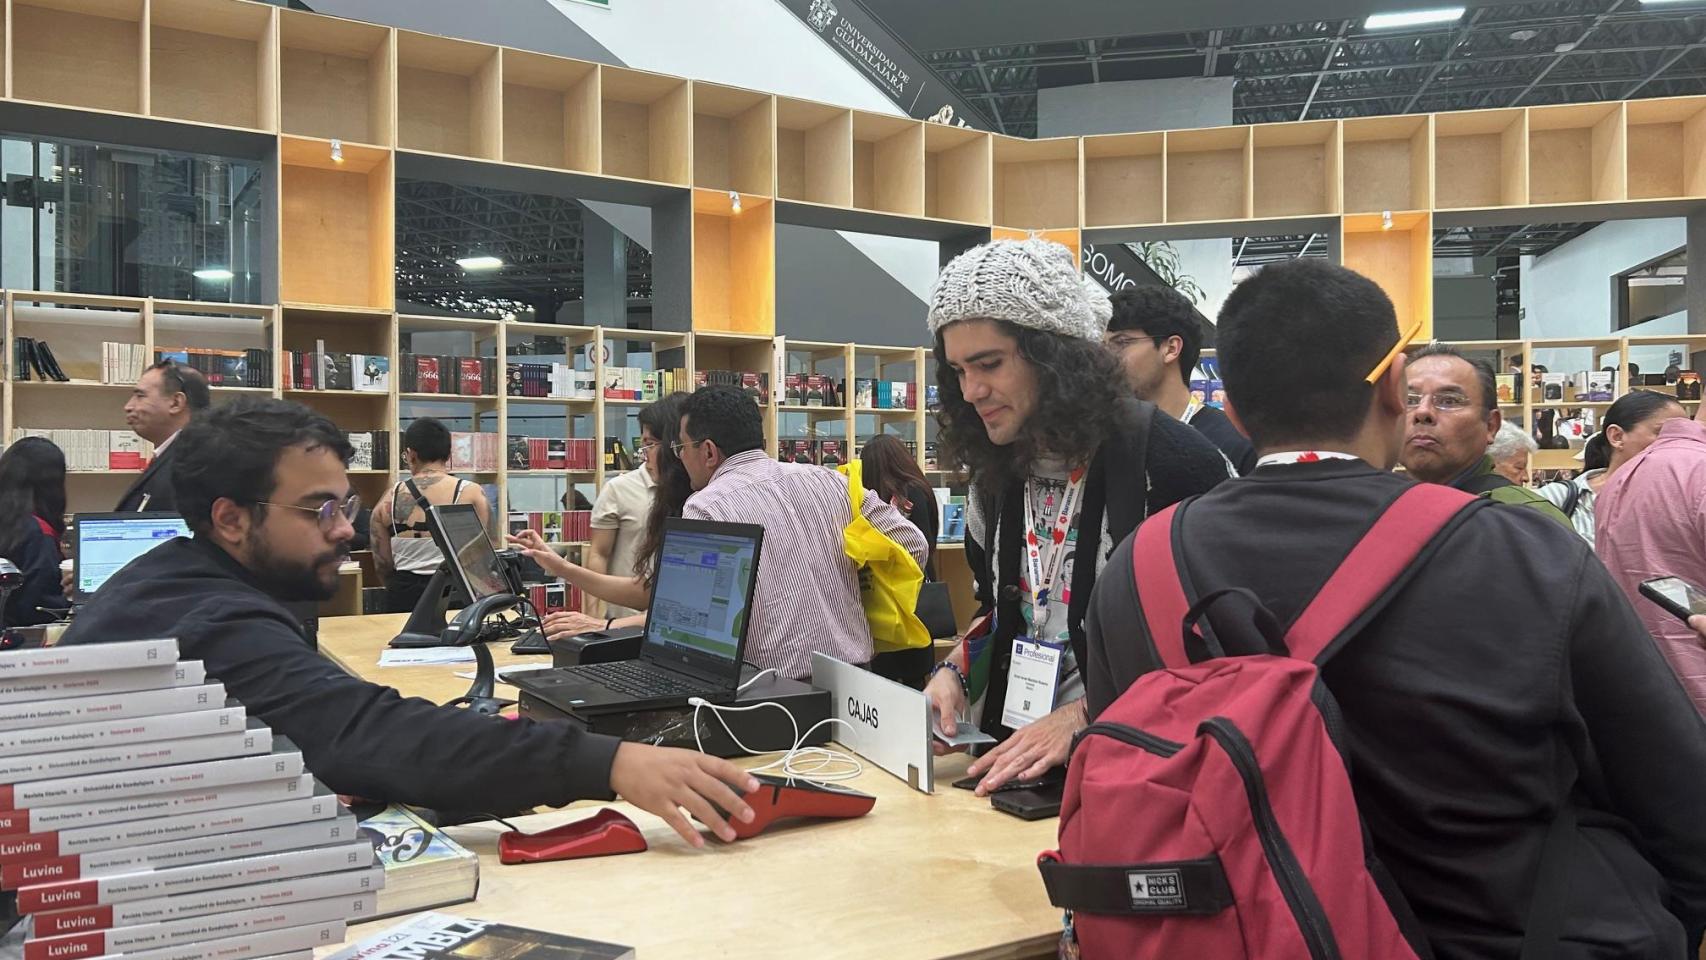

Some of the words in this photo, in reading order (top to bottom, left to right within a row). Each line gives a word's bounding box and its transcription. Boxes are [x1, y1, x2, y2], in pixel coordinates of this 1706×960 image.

[840, 17, 897, 71] UNIVERSIDAD
[897, 67, 910, 84] DE
[835, 26, 904, 93] GUADALAJARA
[848, 696, 879, 729] CAJAS
[1, 842, 41, 856] Luvina
[23, 865, 63, 879] Luvina
[41, 889, 81, 903] Luvina
[1150, 886, 1177, 895] CLUB
[56, 916, 96, 929] Luvina
[380, 918, 490, 960] MBLA
[48, 942, 88, 956] Luvina
